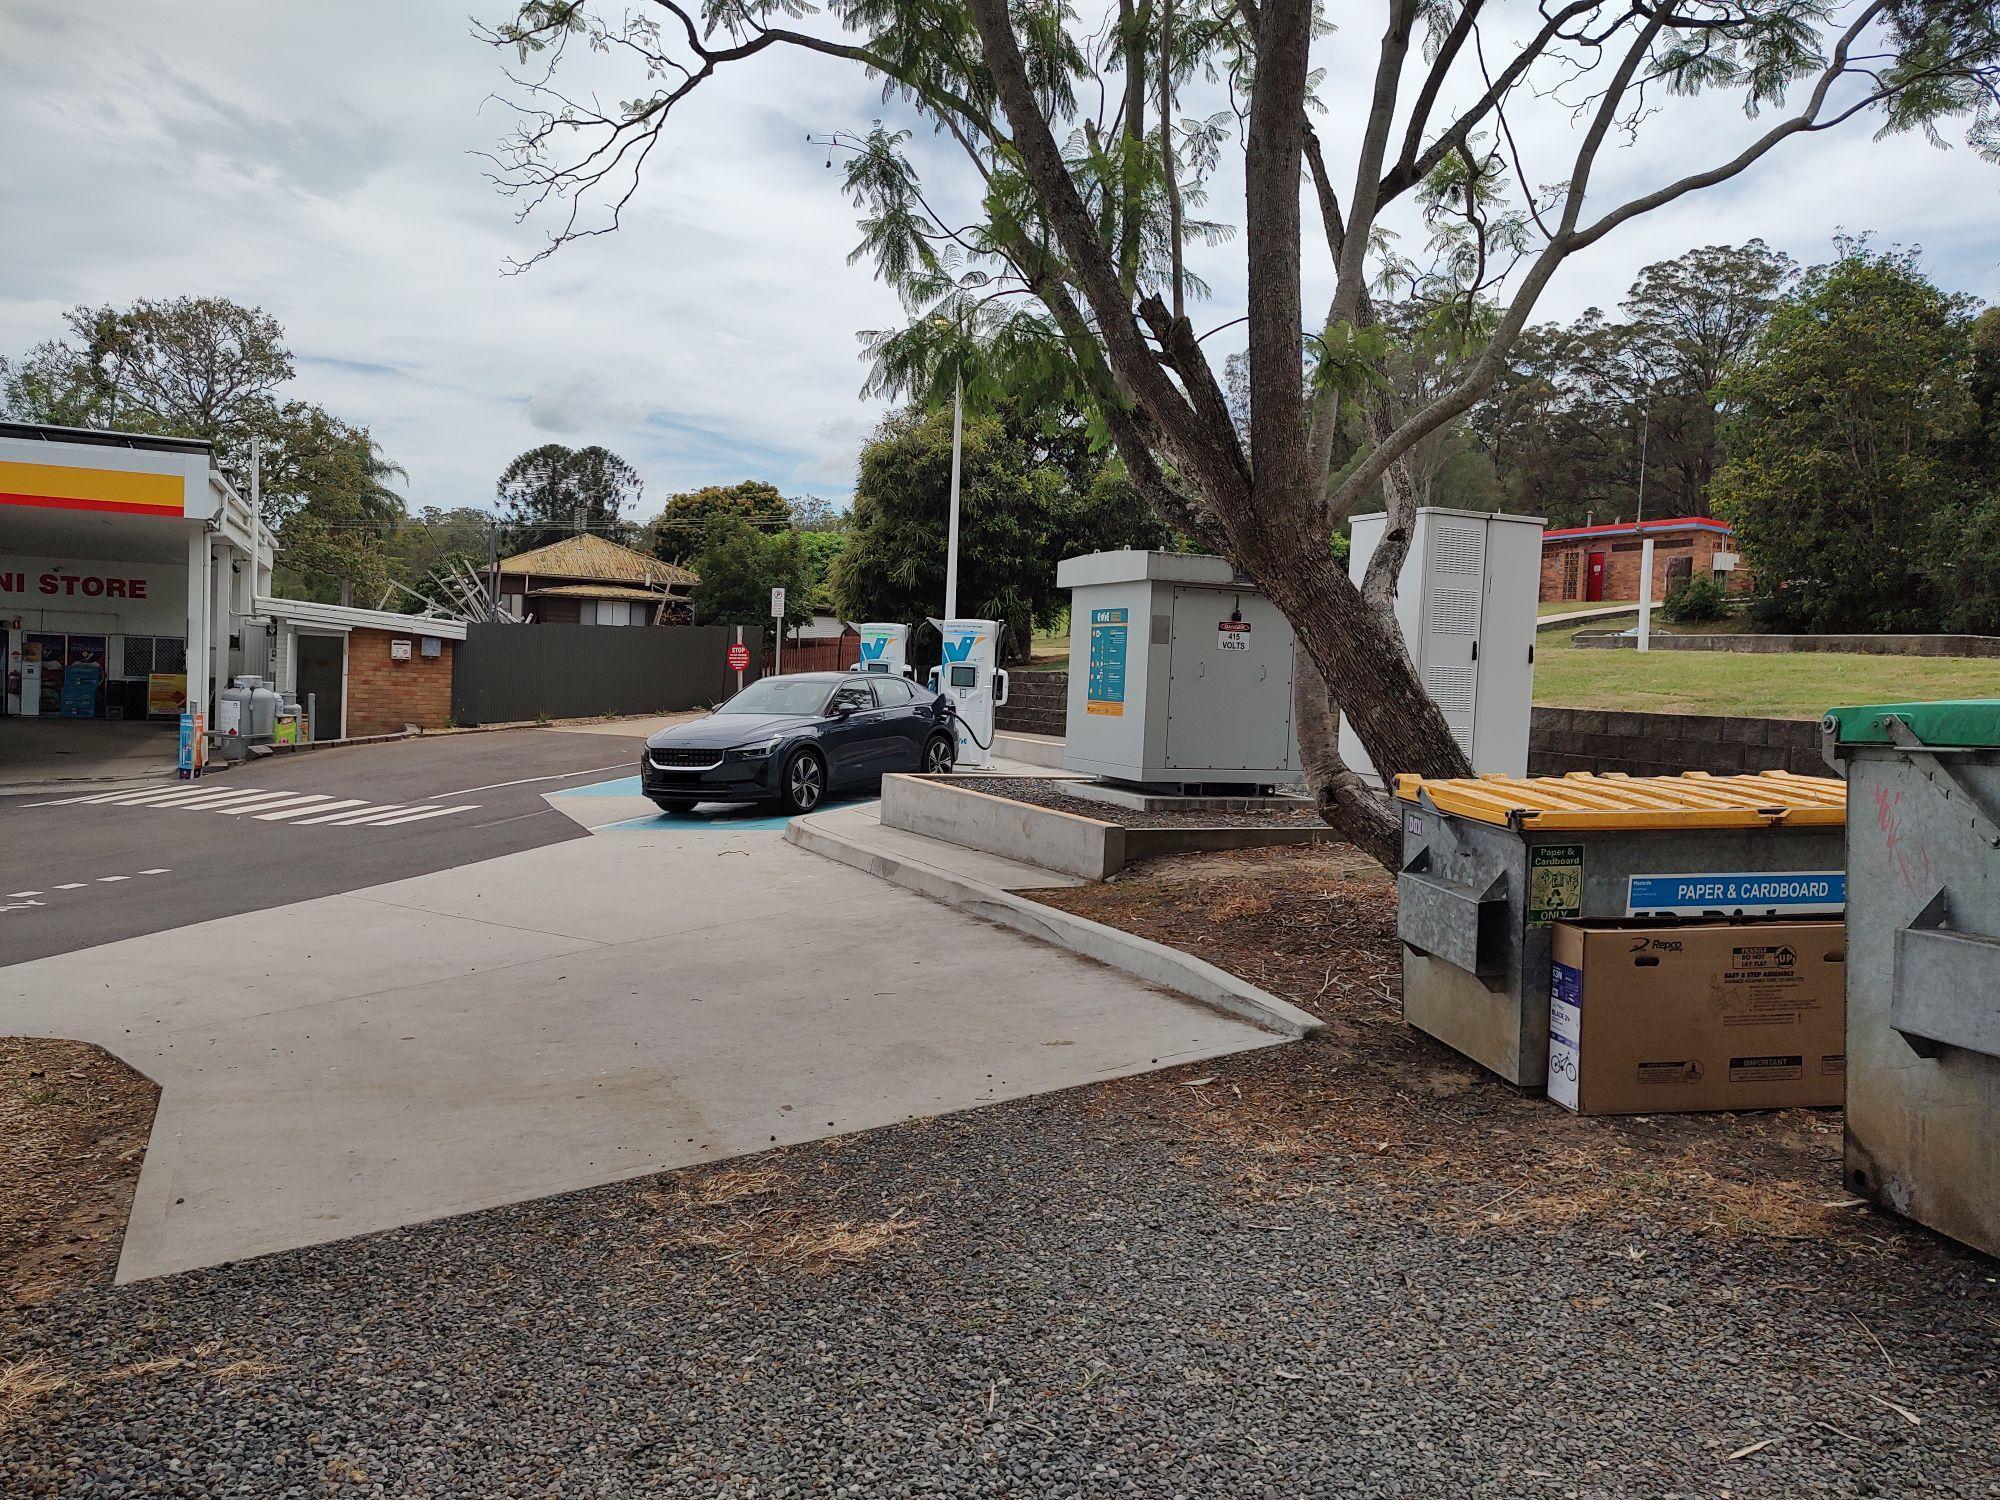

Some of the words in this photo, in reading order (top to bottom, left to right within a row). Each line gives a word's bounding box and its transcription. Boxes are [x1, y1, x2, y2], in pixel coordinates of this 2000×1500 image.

[39, 574, 147, 599] STORE
[1228, 633, 1241, 641] 415
[1222, 641, 1246, 650] VOLTS
[1541, 848, 1566, 857] Paper
[1567, 848, 1575, 856] &
[1535, 857, 1580, 866] Cardboard
[1677, 884, 1724, 900] PAPER
[1727, 884, 1738, 899] &
[1741, 882, 1829, 899] CARDBOARD
[1652, 939, 1683, 951] Repco
[1780, 954, 1793, 963] UP
[1743, 1058, 1787, 1067] IMPORTANT
